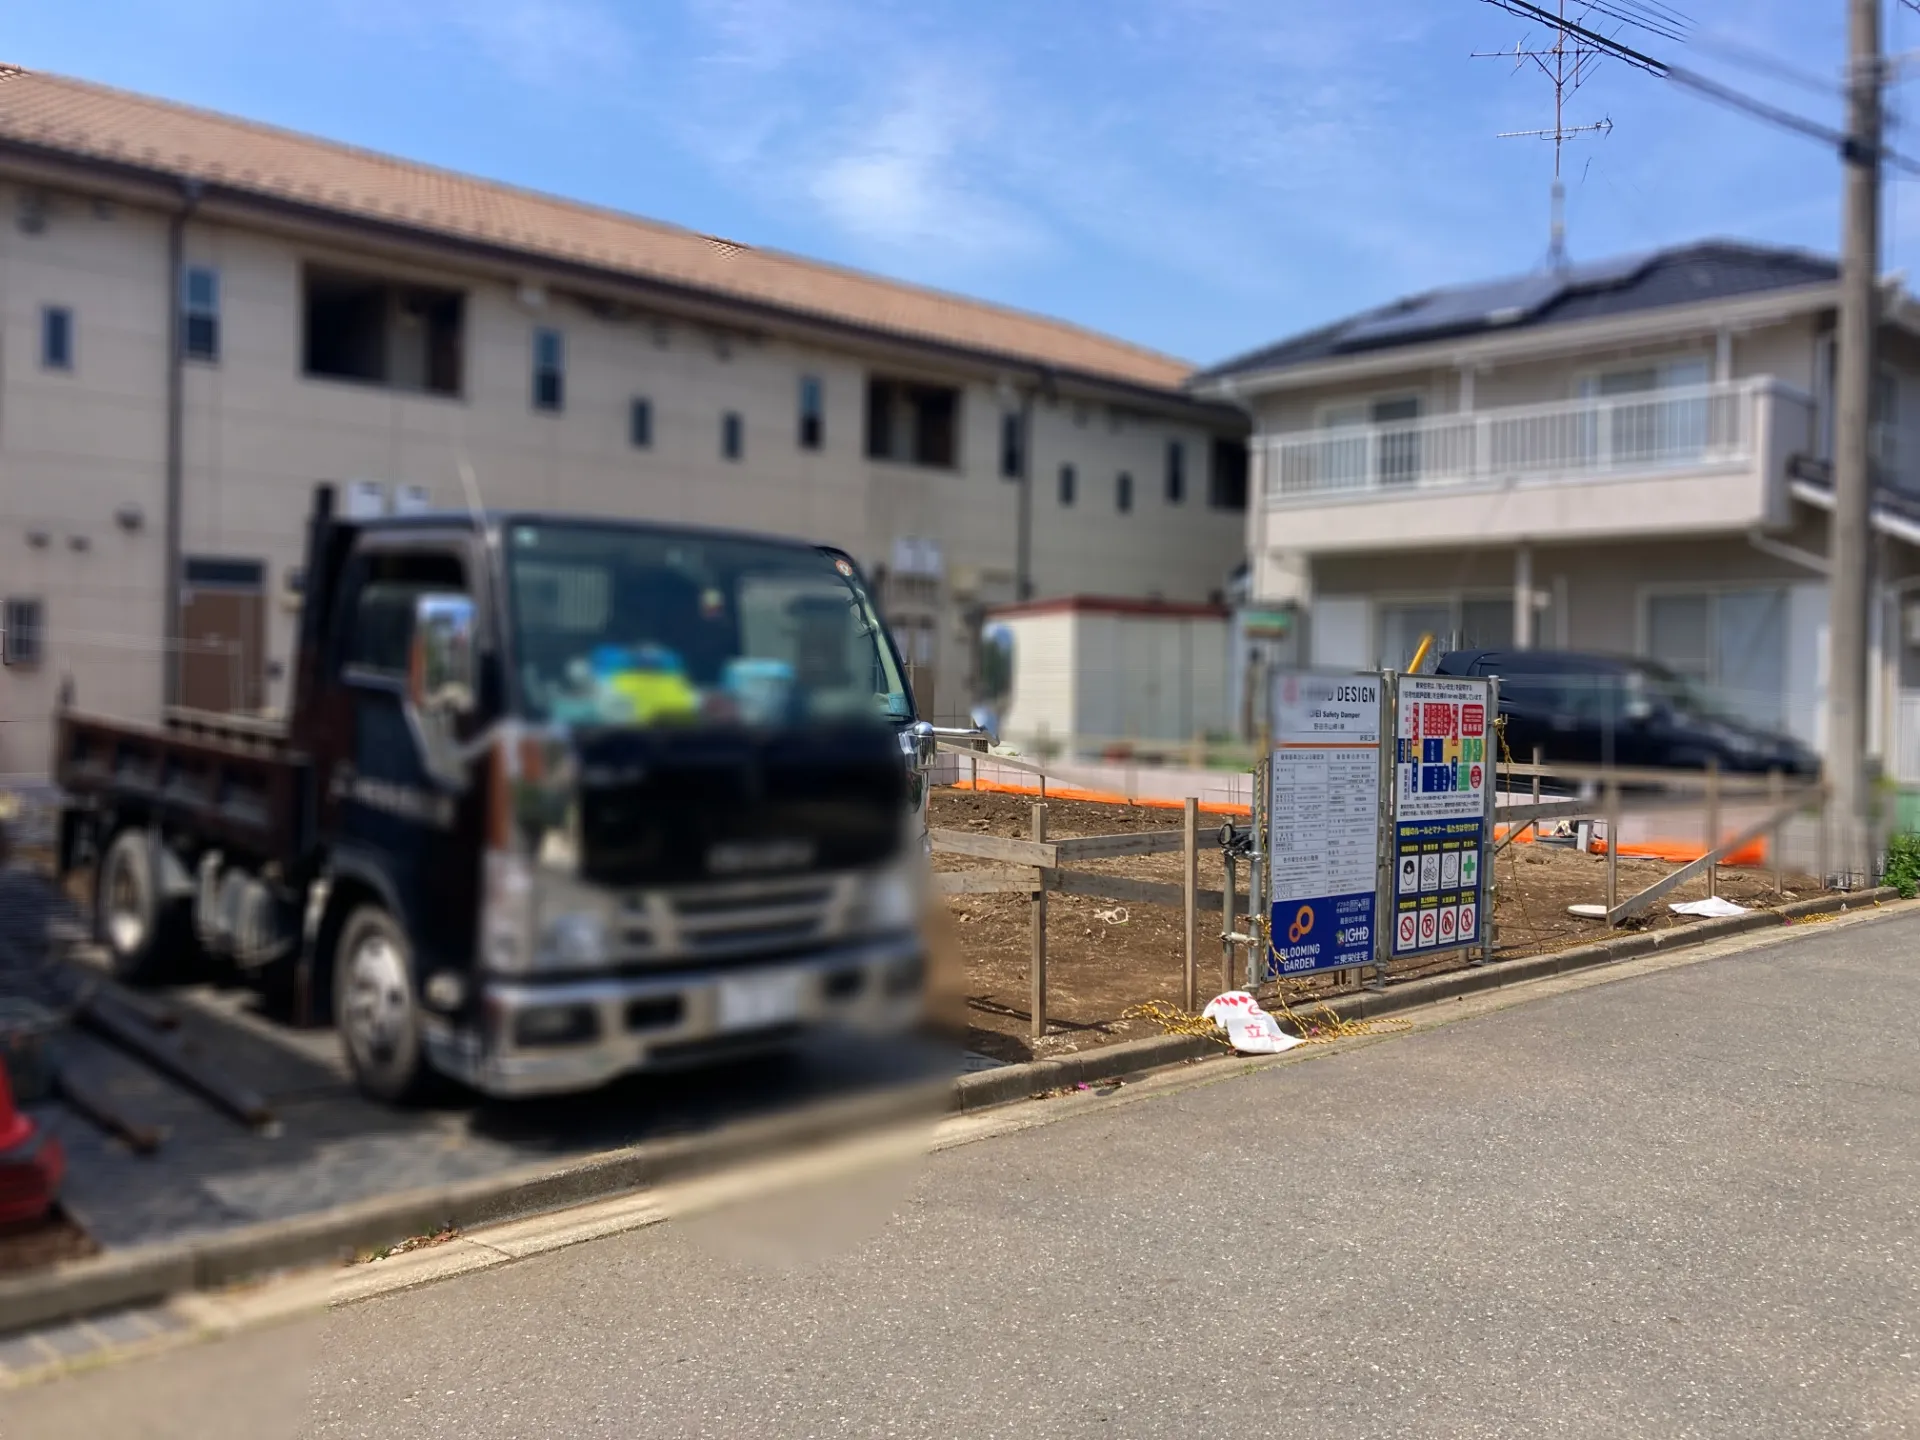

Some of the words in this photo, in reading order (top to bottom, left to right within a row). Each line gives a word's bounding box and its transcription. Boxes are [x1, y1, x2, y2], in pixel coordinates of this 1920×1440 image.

[1337, 687, 1375, 703] DESIGN
[1323, 711, 1339, 719] Safety
[1341, 711, 1360, 719] Damper
[1280, 944, 1320, 958] BLOOMING
[1340, 951, 1368, 964] 東栄住宅
[1284, 957, 1315, 971] GARDEN
